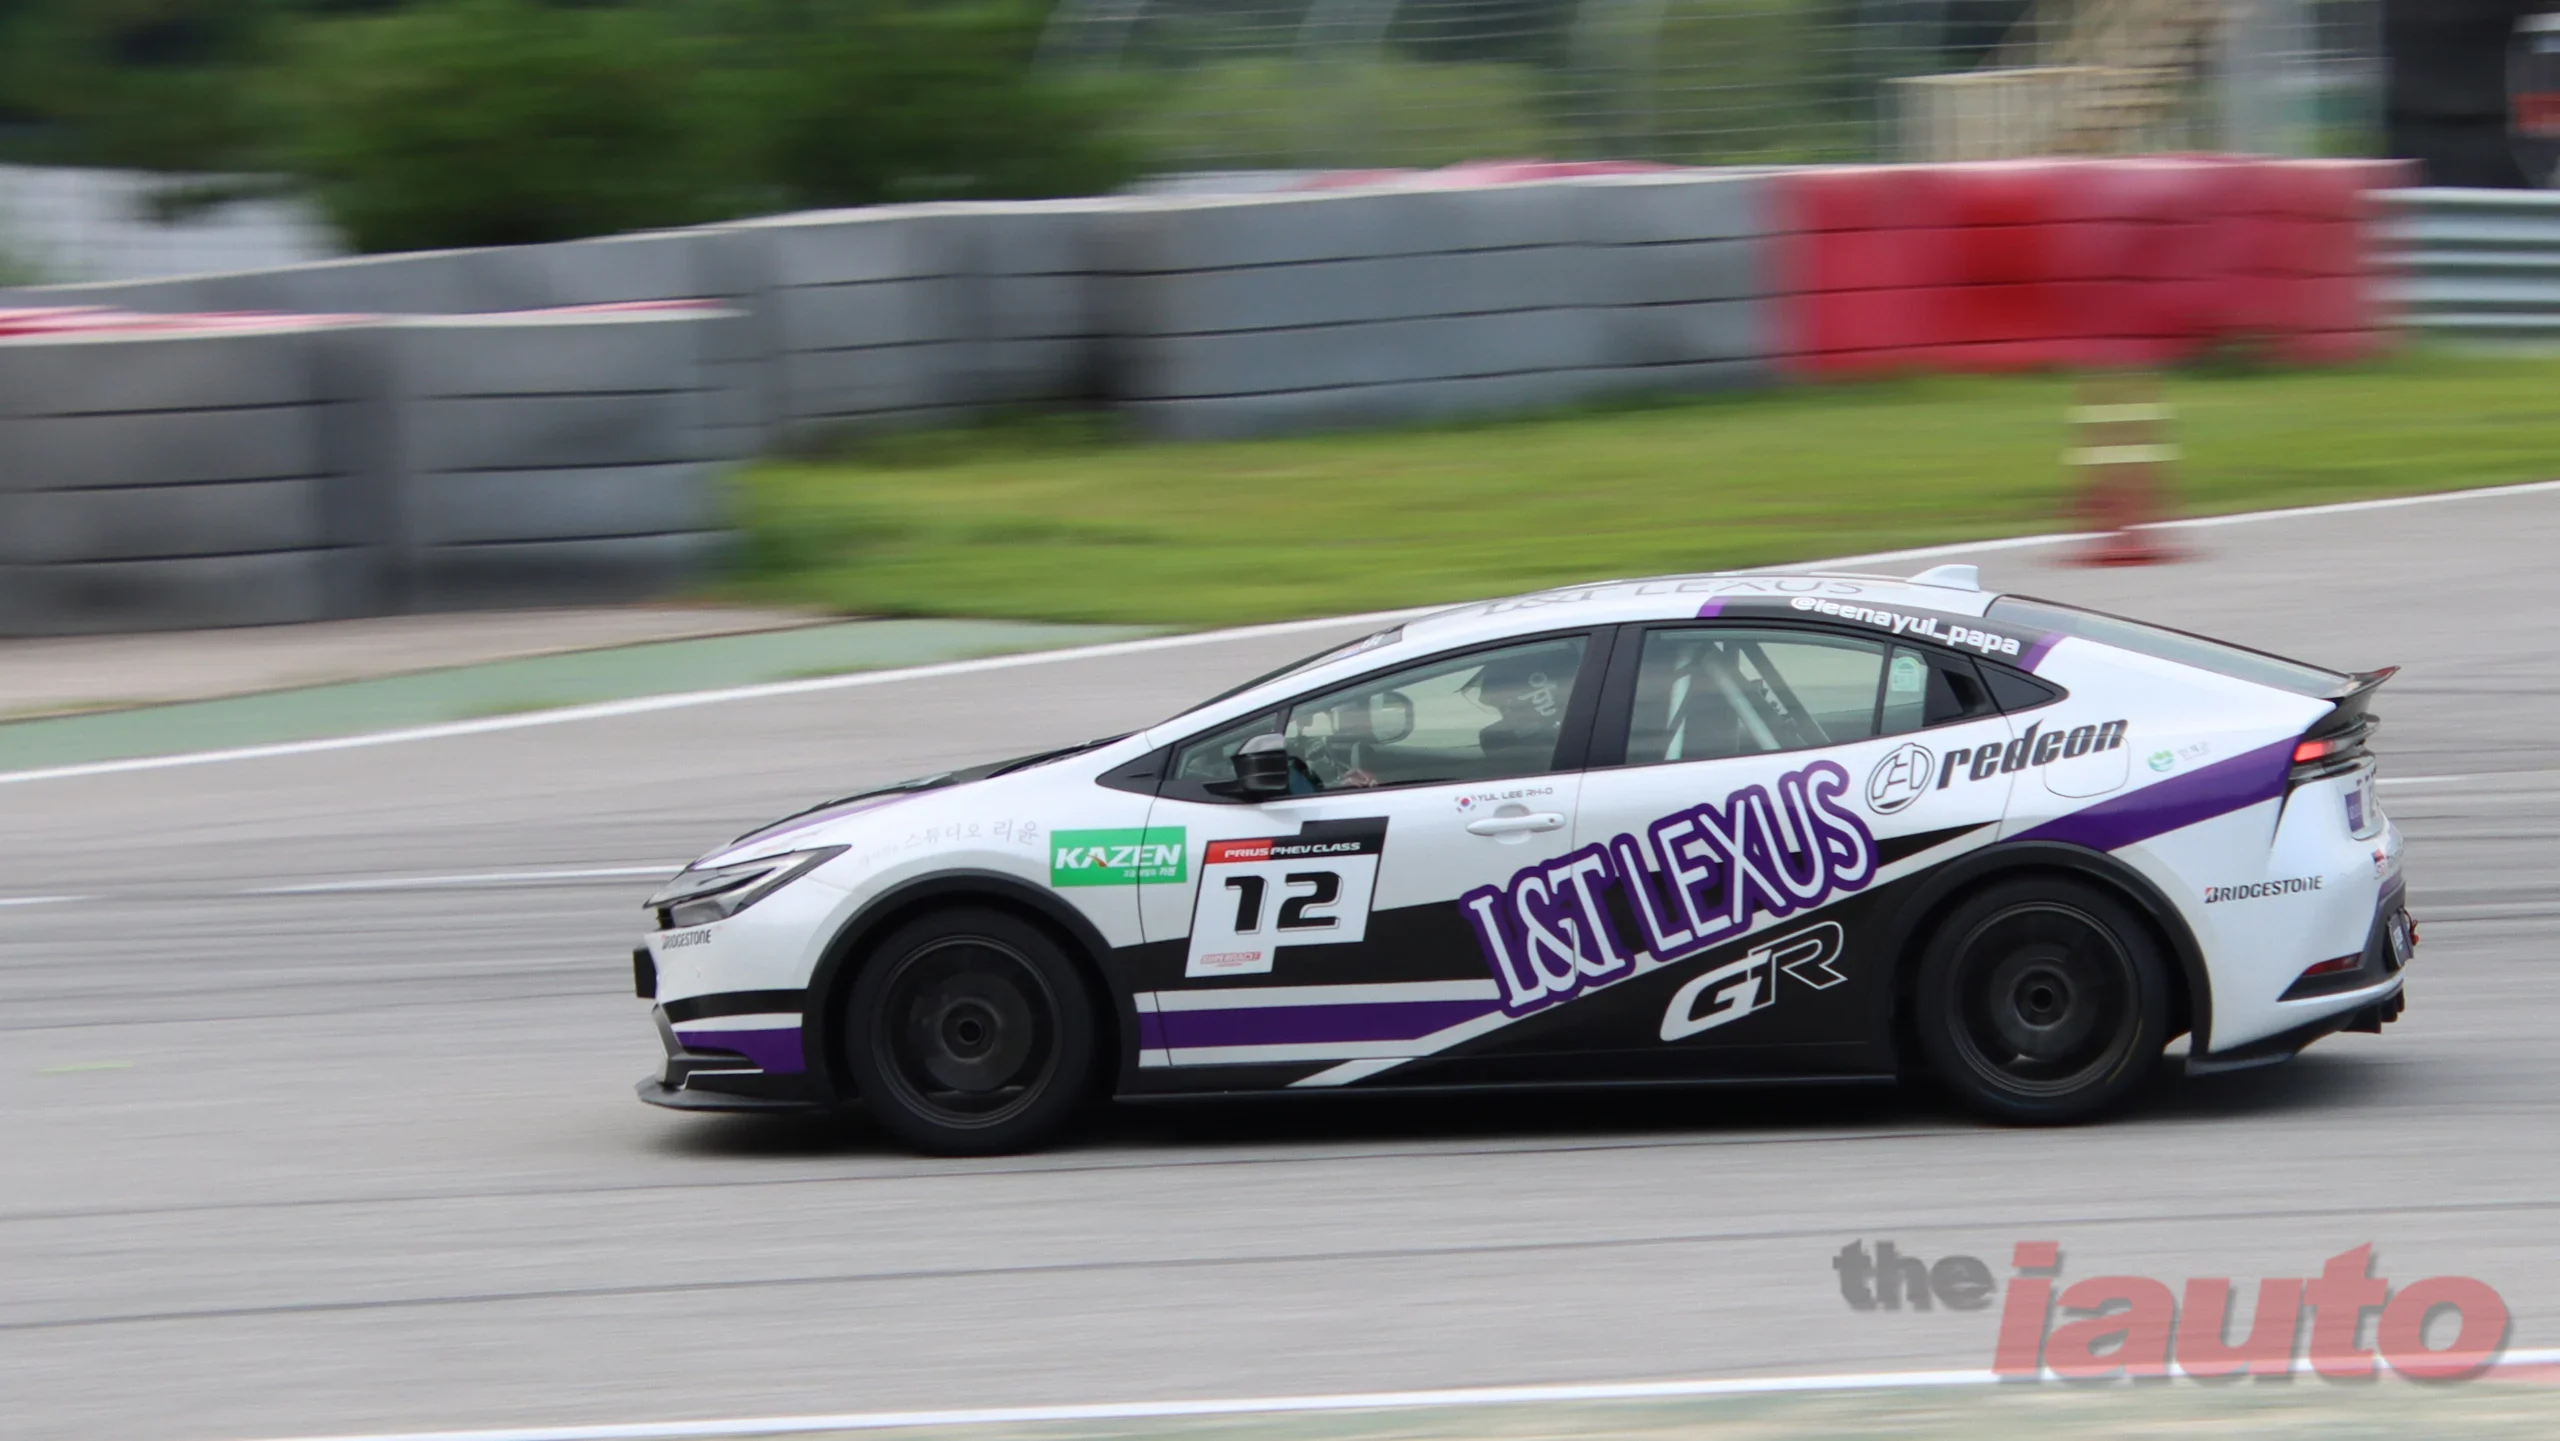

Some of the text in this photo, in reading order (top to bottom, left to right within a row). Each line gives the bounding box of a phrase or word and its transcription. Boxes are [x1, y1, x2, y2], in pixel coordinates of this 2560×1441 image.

[1634, 579, 1863, 597] LEXUS
[1936, 718, 2128, 790] redcon
[1501, 790, 1523, 800] LEE
[905, 822, 983, 850] 스튜디오
[1224, 842, 1361, 858] PRIUS PHEV CLASS
[1054, 843, 1182, 870] KAZEN
[1469, 768, 1869, 1008] I&T LEXUS
[2204, 876, 2323, 904] BRIDGESTONE
[1225, 871, 1343, 935] 12
[661, 929, 712, 951] BRIDGESTONE
[1659, 921, 1847, 1042] GR
